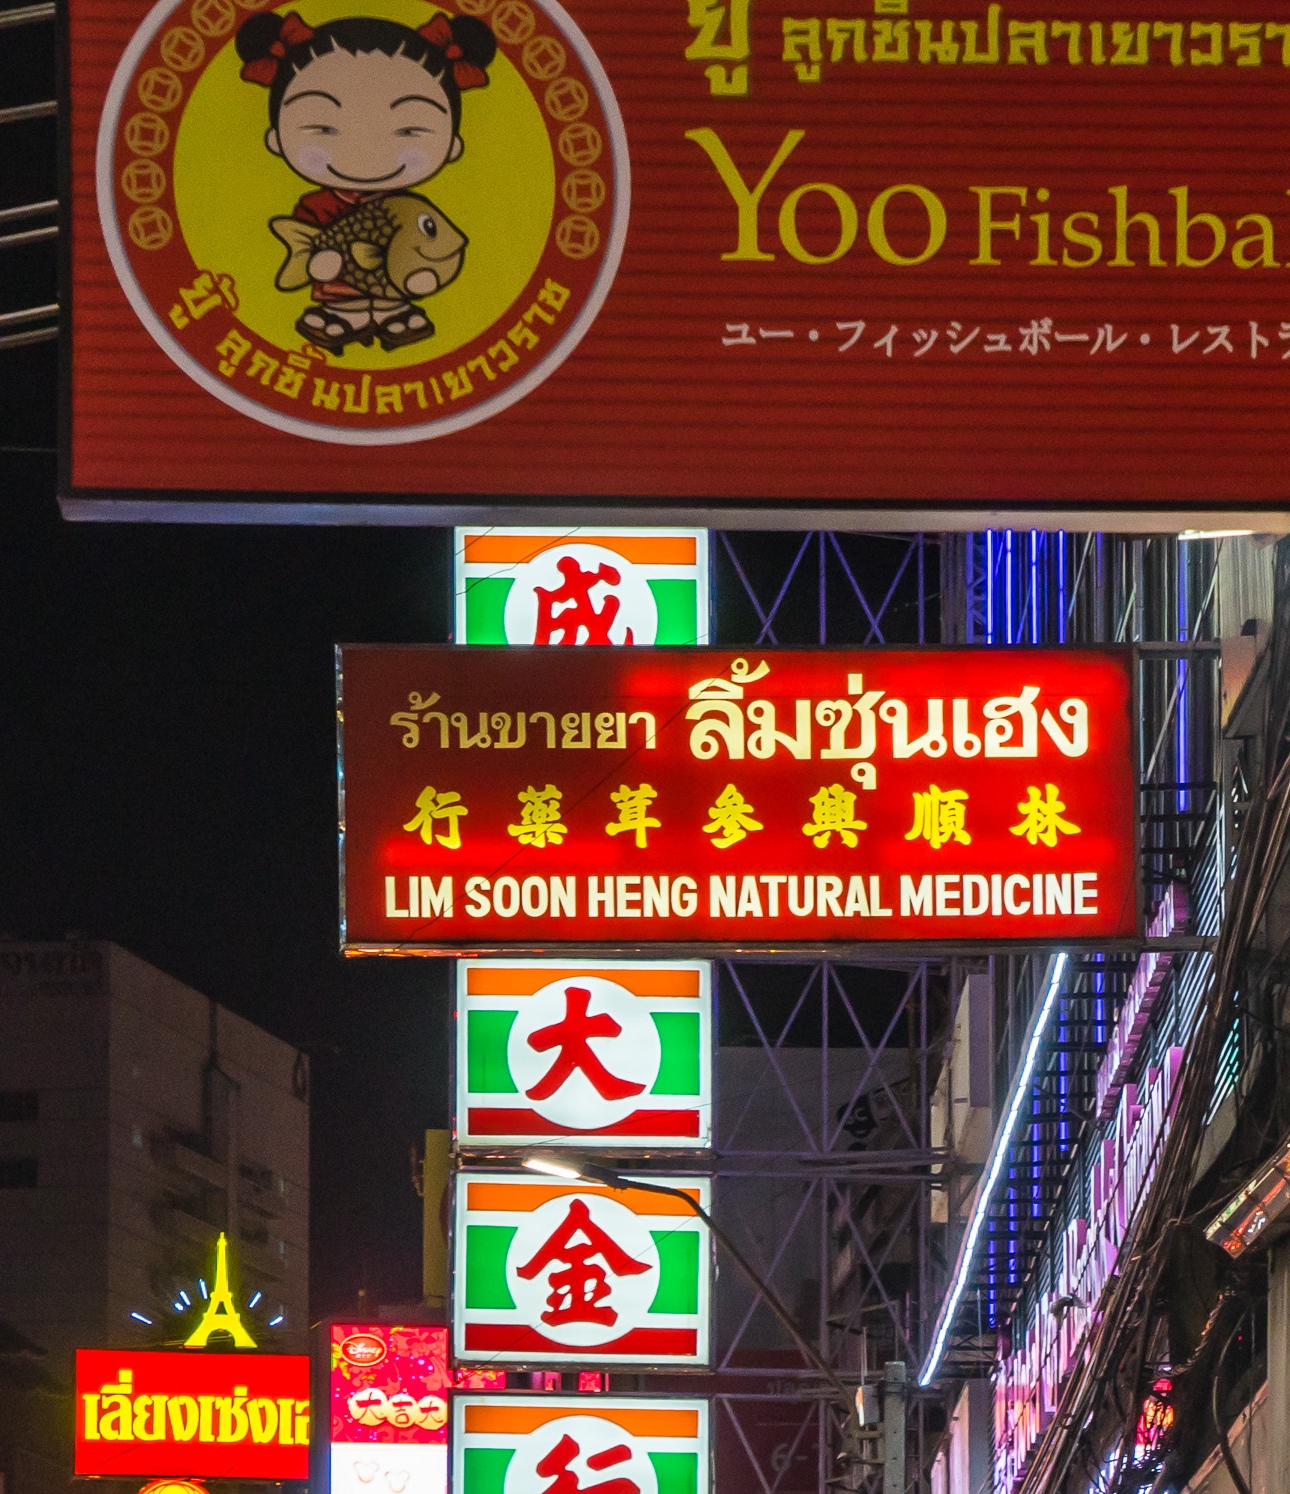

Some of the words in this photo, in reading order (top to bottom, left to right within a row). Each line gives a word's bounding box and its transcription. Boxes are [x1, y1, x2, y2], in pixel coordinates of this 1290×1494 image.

[683, 0, 751, 96] ยู
[390, 690, 657, 750] ร้านขายยา
[686, 657, 1089, 790] ลิ้มซุ่นเฮง
[385, 875, 454, 918] LIM
[465, 875, 577, 918] SOON
[588, 875, 699, 918] HENG
[710, 874, 892, 917] NATURAL
[900, 871, 1098, 917] MEDICINE
[355, 1391, 445, 1425] 大吉大
